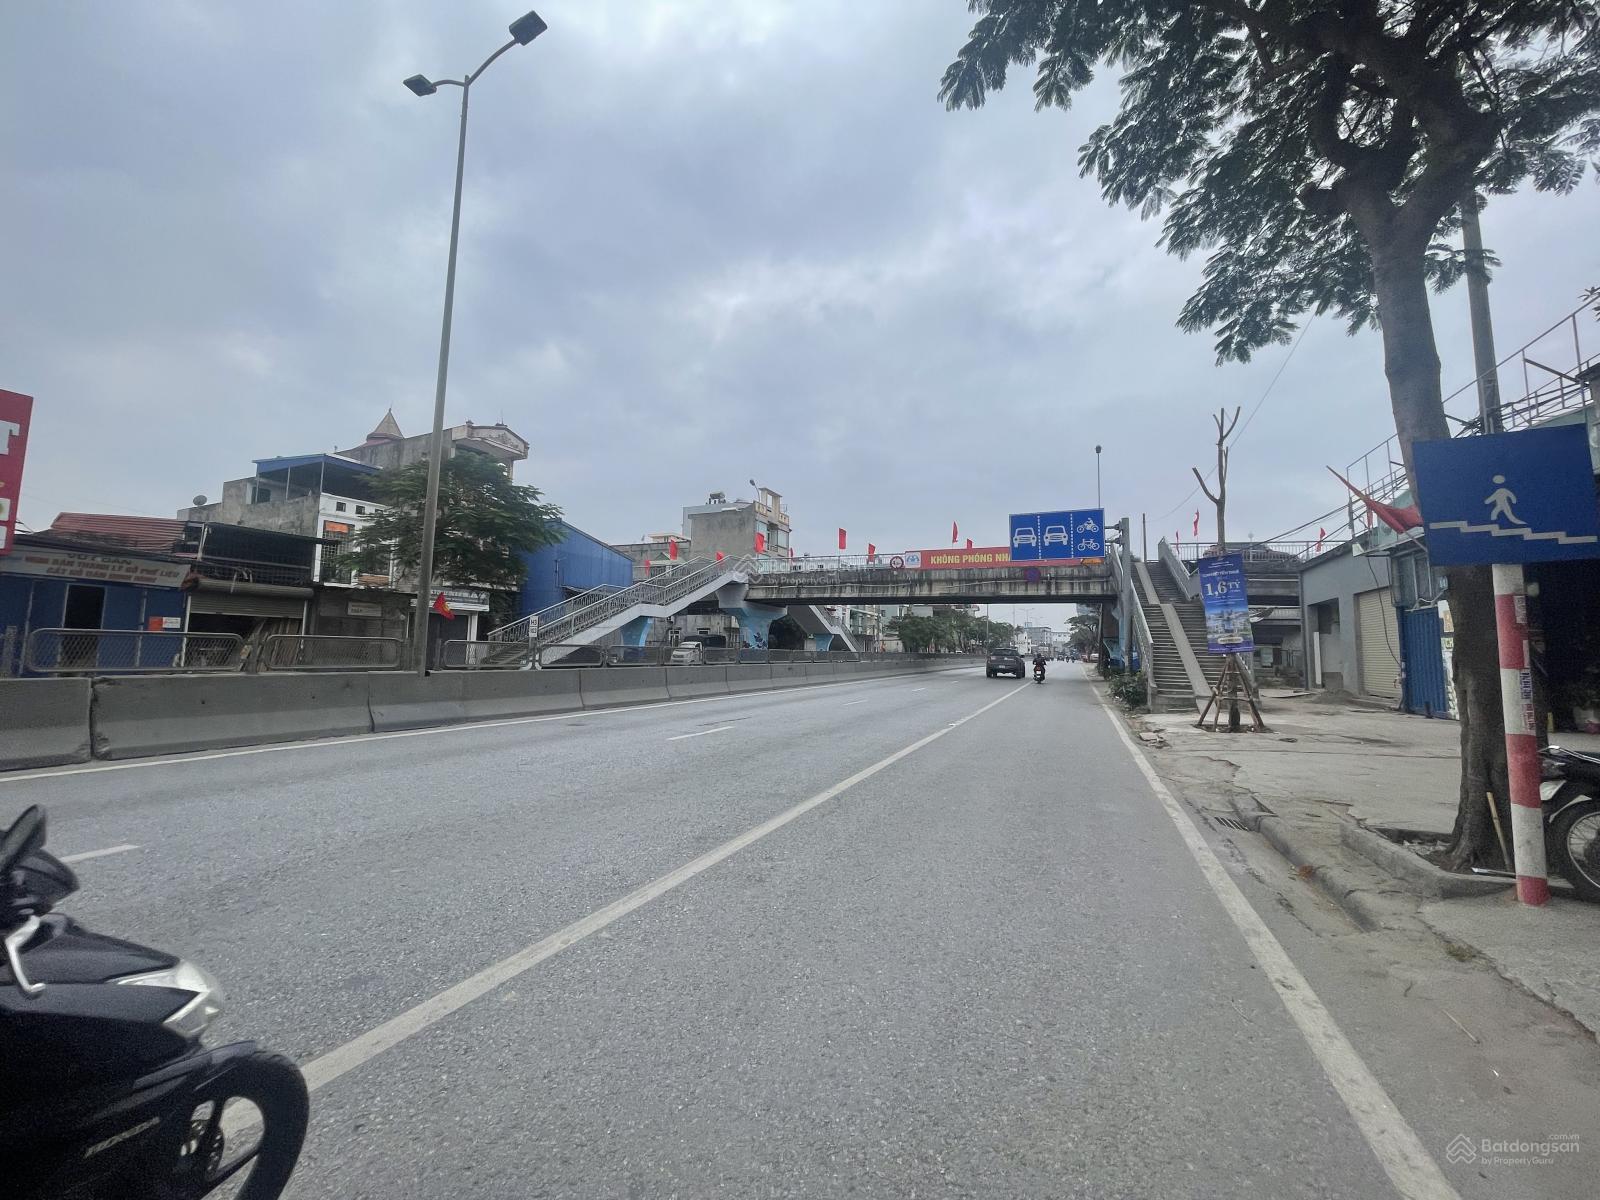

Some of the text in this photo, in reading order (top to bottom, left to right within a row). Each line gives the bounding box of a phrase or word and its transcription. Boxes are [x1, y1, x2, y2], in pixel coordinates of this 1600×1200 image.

[930, 552, 1011, 565] KHÔNG PHÓNG NH
